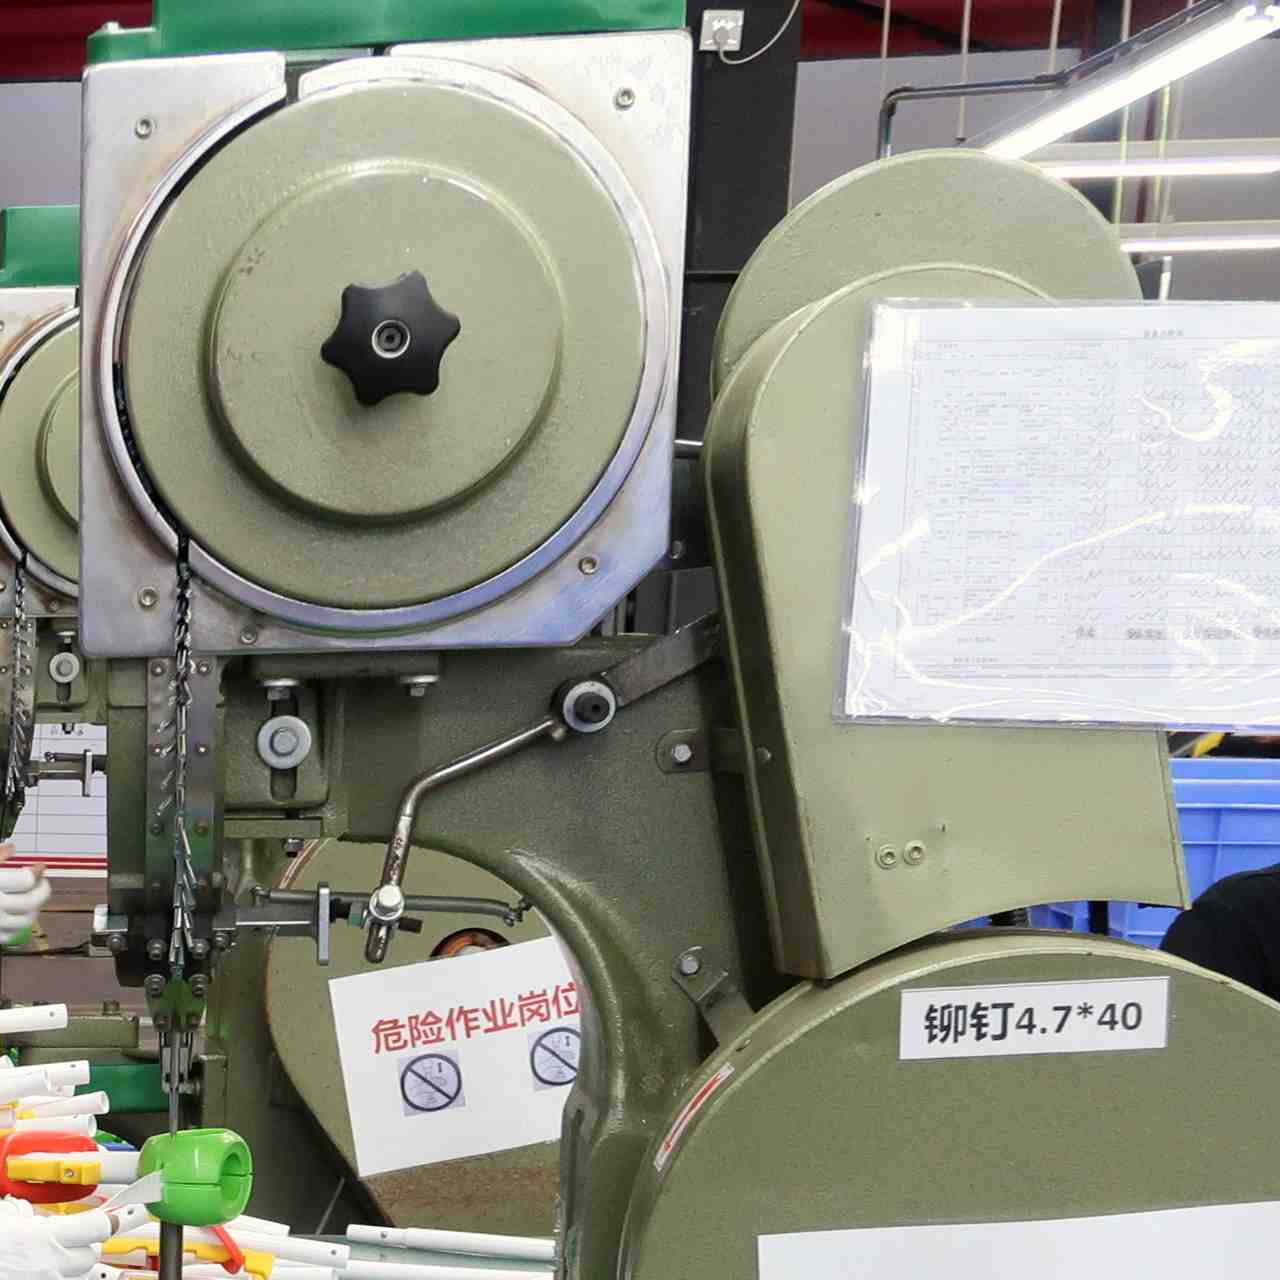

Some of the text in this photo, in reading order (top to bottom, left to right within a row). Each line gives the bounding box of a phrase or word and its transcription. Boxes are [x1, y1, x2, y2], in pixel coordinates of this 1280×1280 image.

[370, 981, 581, 1055] 危险作业岗位
